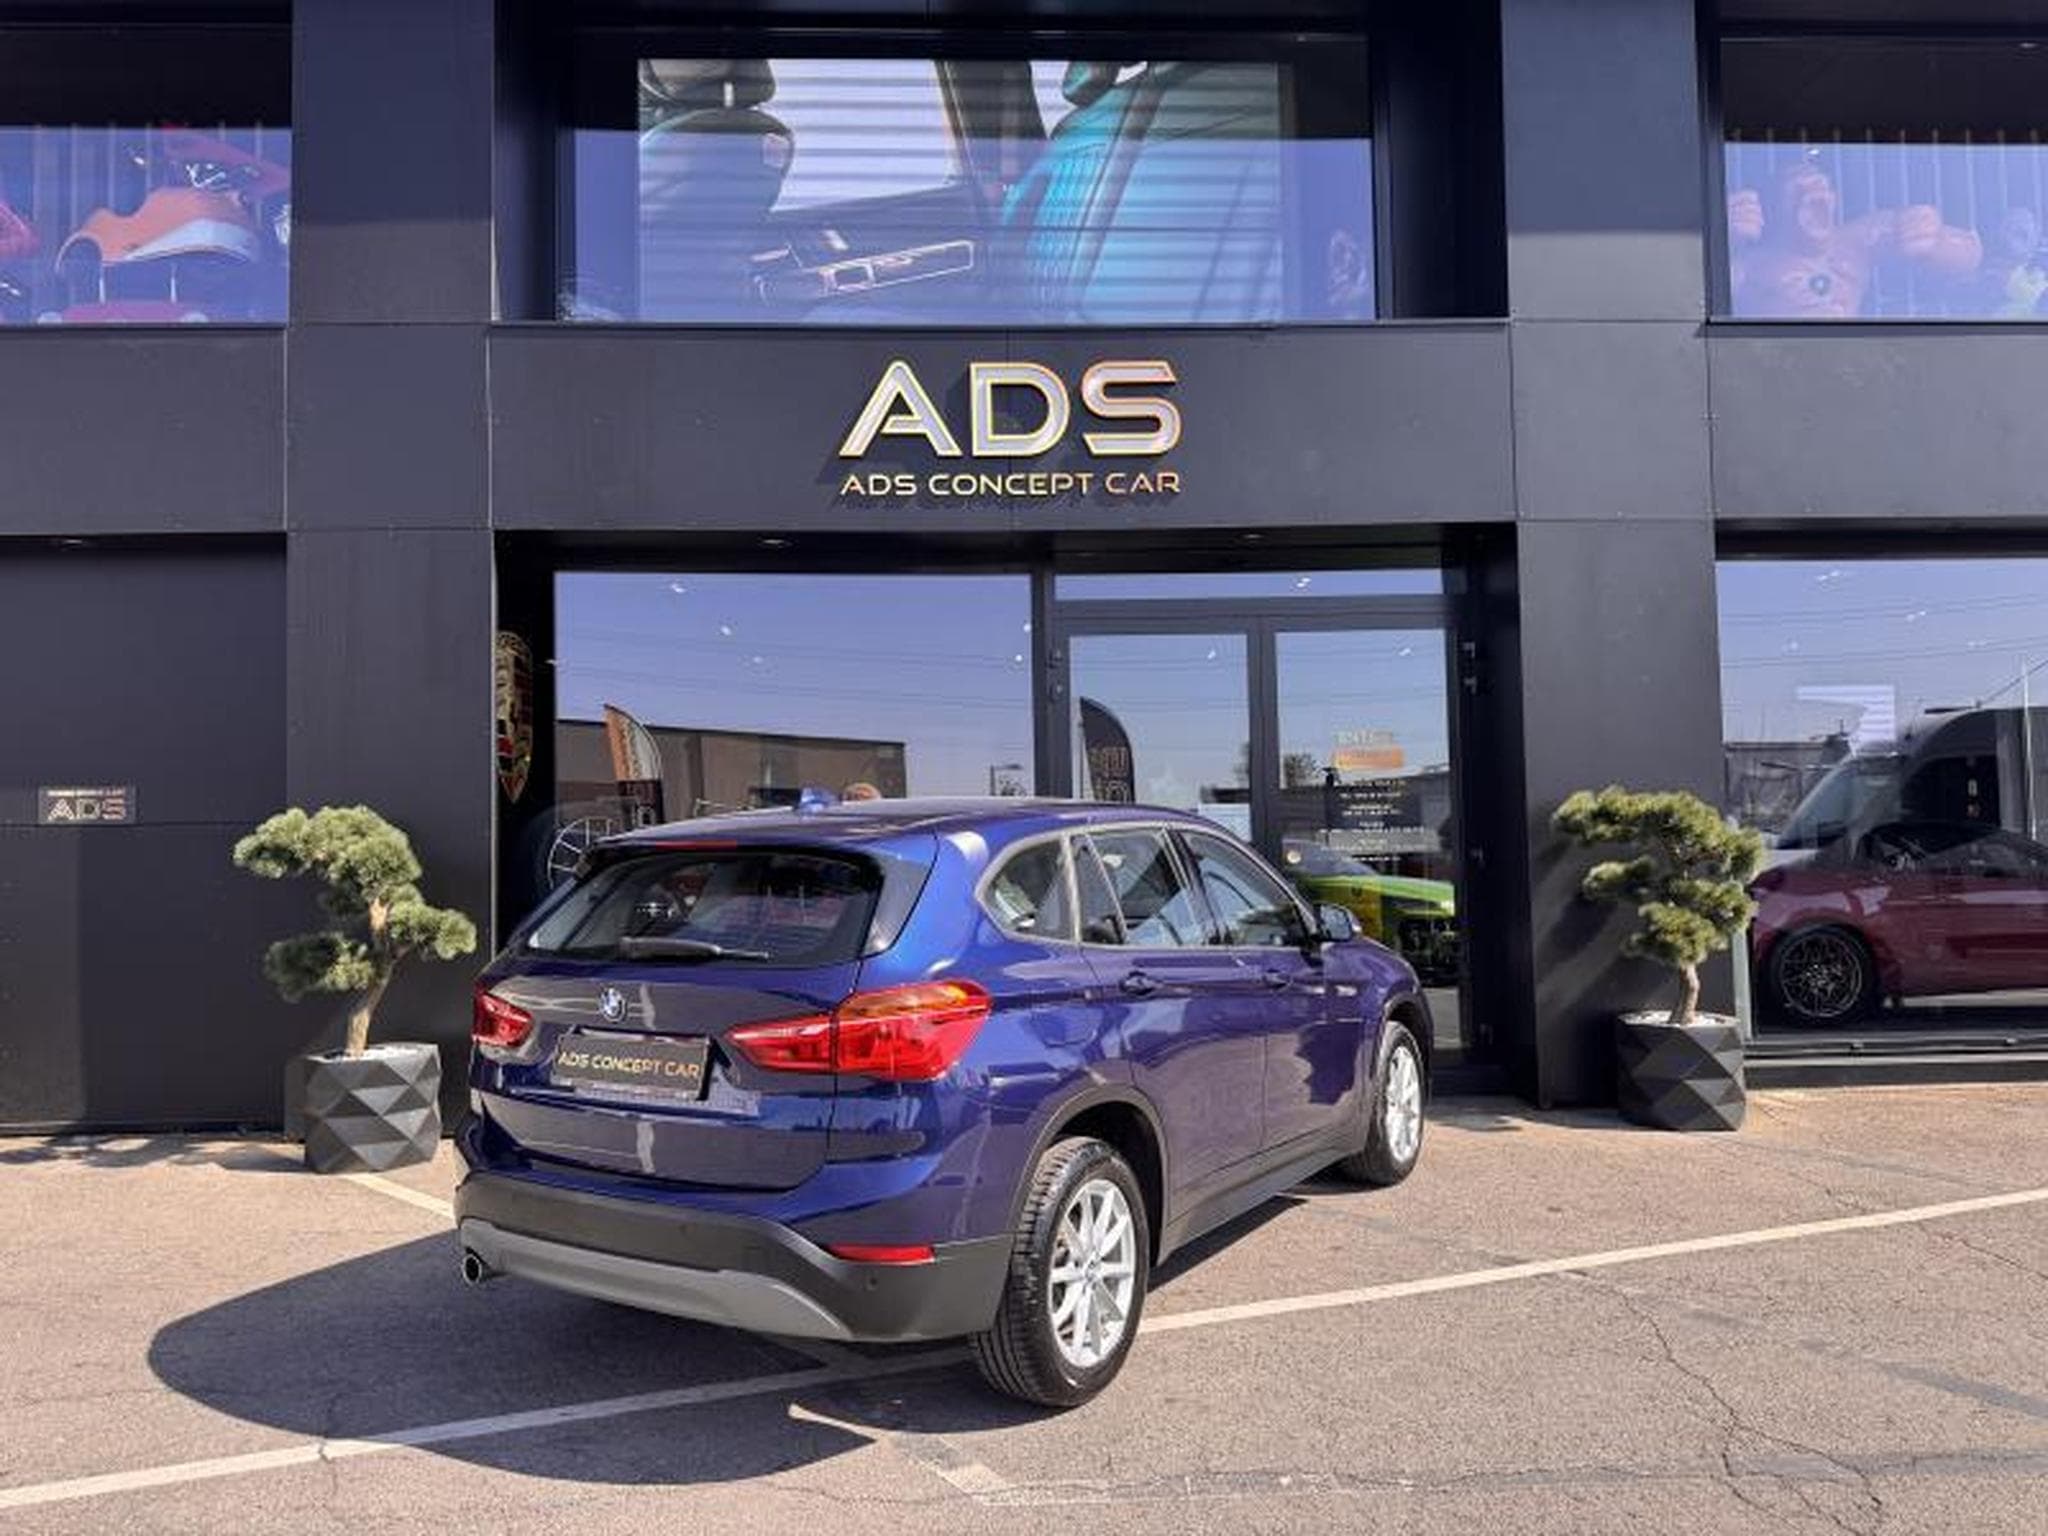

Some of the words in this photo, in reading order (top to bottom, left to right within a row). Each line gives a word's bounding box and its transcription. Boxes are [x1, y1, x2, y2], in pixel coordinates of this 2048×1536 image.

[838, 360, 1183, 457] ADS
[839, 473, 916, 497] ADS
[928, 472, 1094, 497] CONCEPT
[1105, 471, 1181, 495] CAR
[47, 798, 127, 821] ADS
[558, 1051, 590, 1069] ADS
[592, 1054, 661, 1075] CONCEPT
[664, 1061, 700, 1079] CAR
